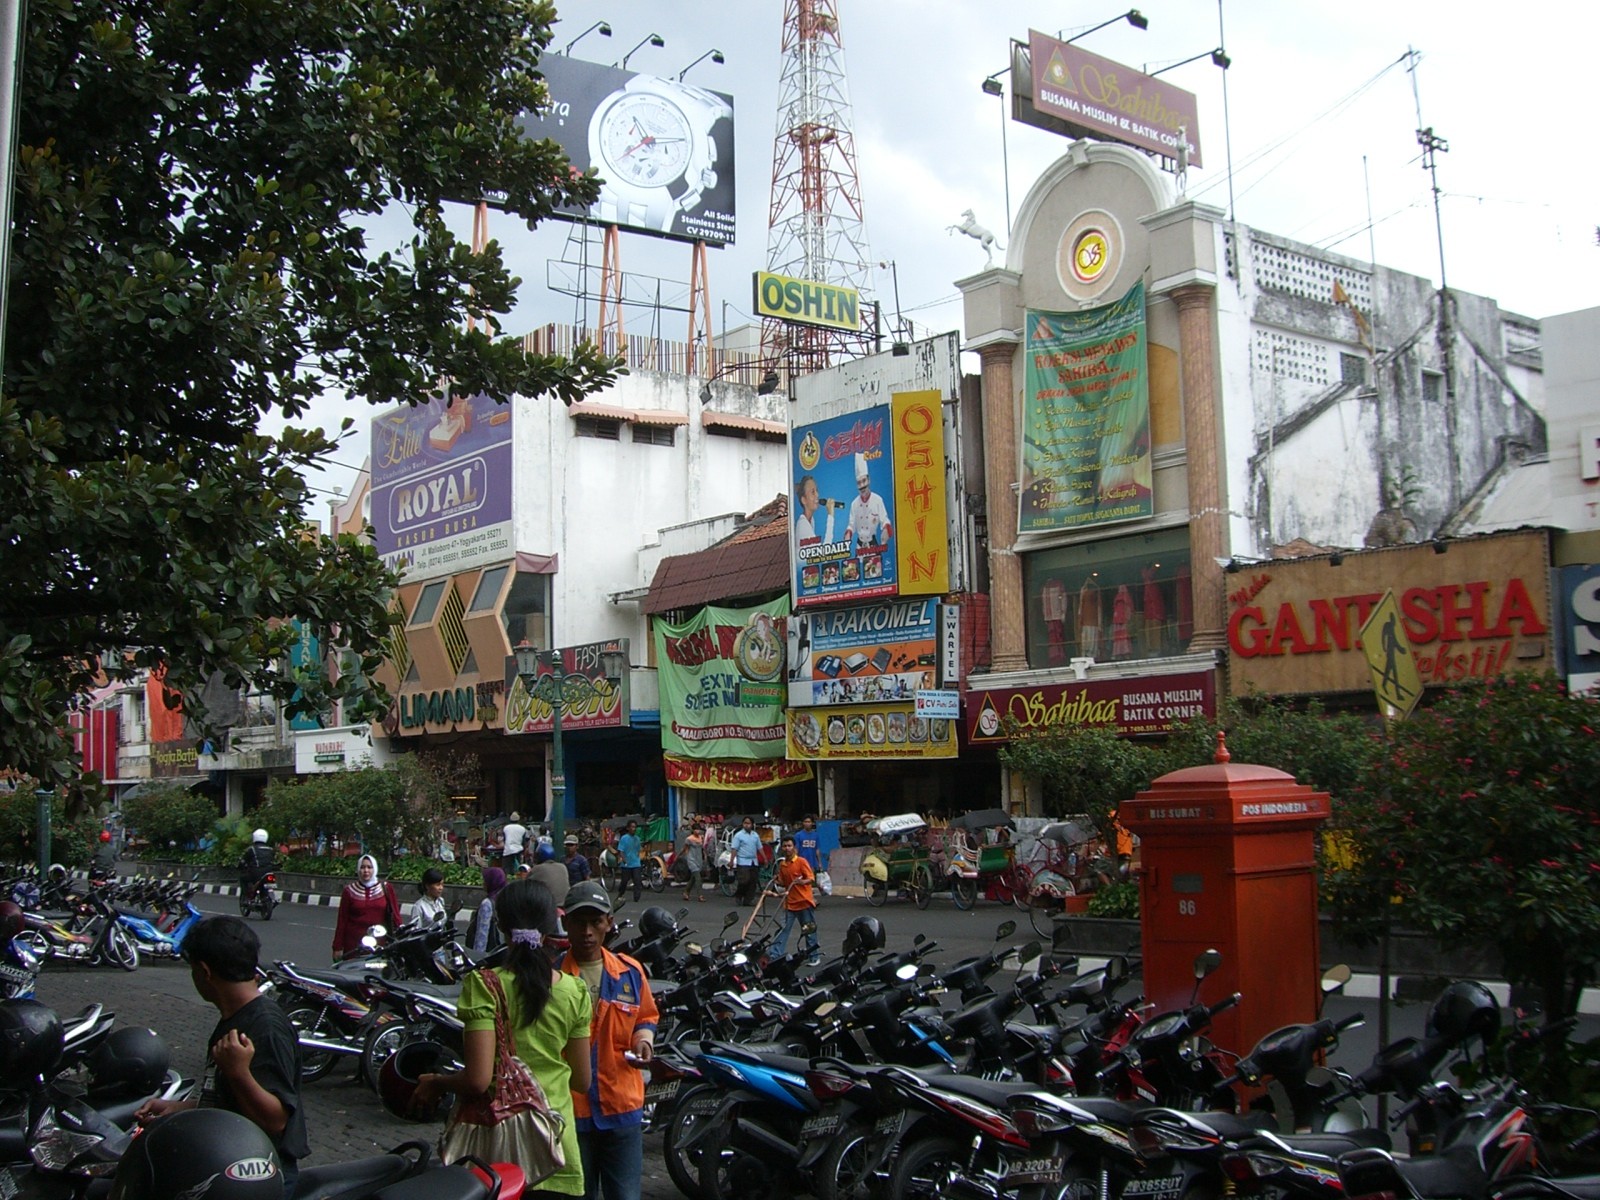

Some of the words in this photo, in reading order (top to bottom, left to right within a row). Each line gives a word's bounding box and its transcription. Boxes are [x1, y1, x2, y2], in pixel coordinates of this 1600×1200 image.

[1041, 90, 1080, 113] BUSANA
[1082, 104, 1117, 126] MUSLIM
[1120, 117, 1130, 130] &
[1132, 123, 1158, 141] BATIK
[681, 215, 715, 228] Stainless
[717, 223, 735, 233] Steel
[703, 210, 715, 219] All
[716, 212, 735, 222] Solid
[687, 226, 698, 235] CV
[699, 229, 735, 242] 29709-11
[762, 277, 857, 325] OSHIN
[397, 467, 477, 523] ROYAL
[445, 515, 478, 535] BUSA
[800, 546, 824, 559] OPEN
[825, 541, 851, 556] DAILY
[831, 602, 931, 635] RAKOMEL
[946, 622, 957, 677] WARTEL
[685, 692, 719, 710] SUPER
[926, 699, 935, 708] CV
[1123, 693, 1161, 706] BUSANA
[1163, 689, 1202, 702] MUSLIM
[400, 686, 475, 728] LIMAN
[1009, 689, 1120, 727] Sahibaa
[1123, 707, 1154, 721] BATIK
[1157, 705, 1203, 719] CORNER
[1150, 808, 1165, 819] BIS
[1168, 807, 1200, 819] SURAT
[1242, 803, 1261, 815] POS
[1262, 802, 1308, 815] INDONESIA
[1179, 900, 1196, 915] 86
[237, 1156, 272, 1178] MIX
[1024, 1159, 1052, 1171] 3205
[1054, 1157, 1062, 1170] J
